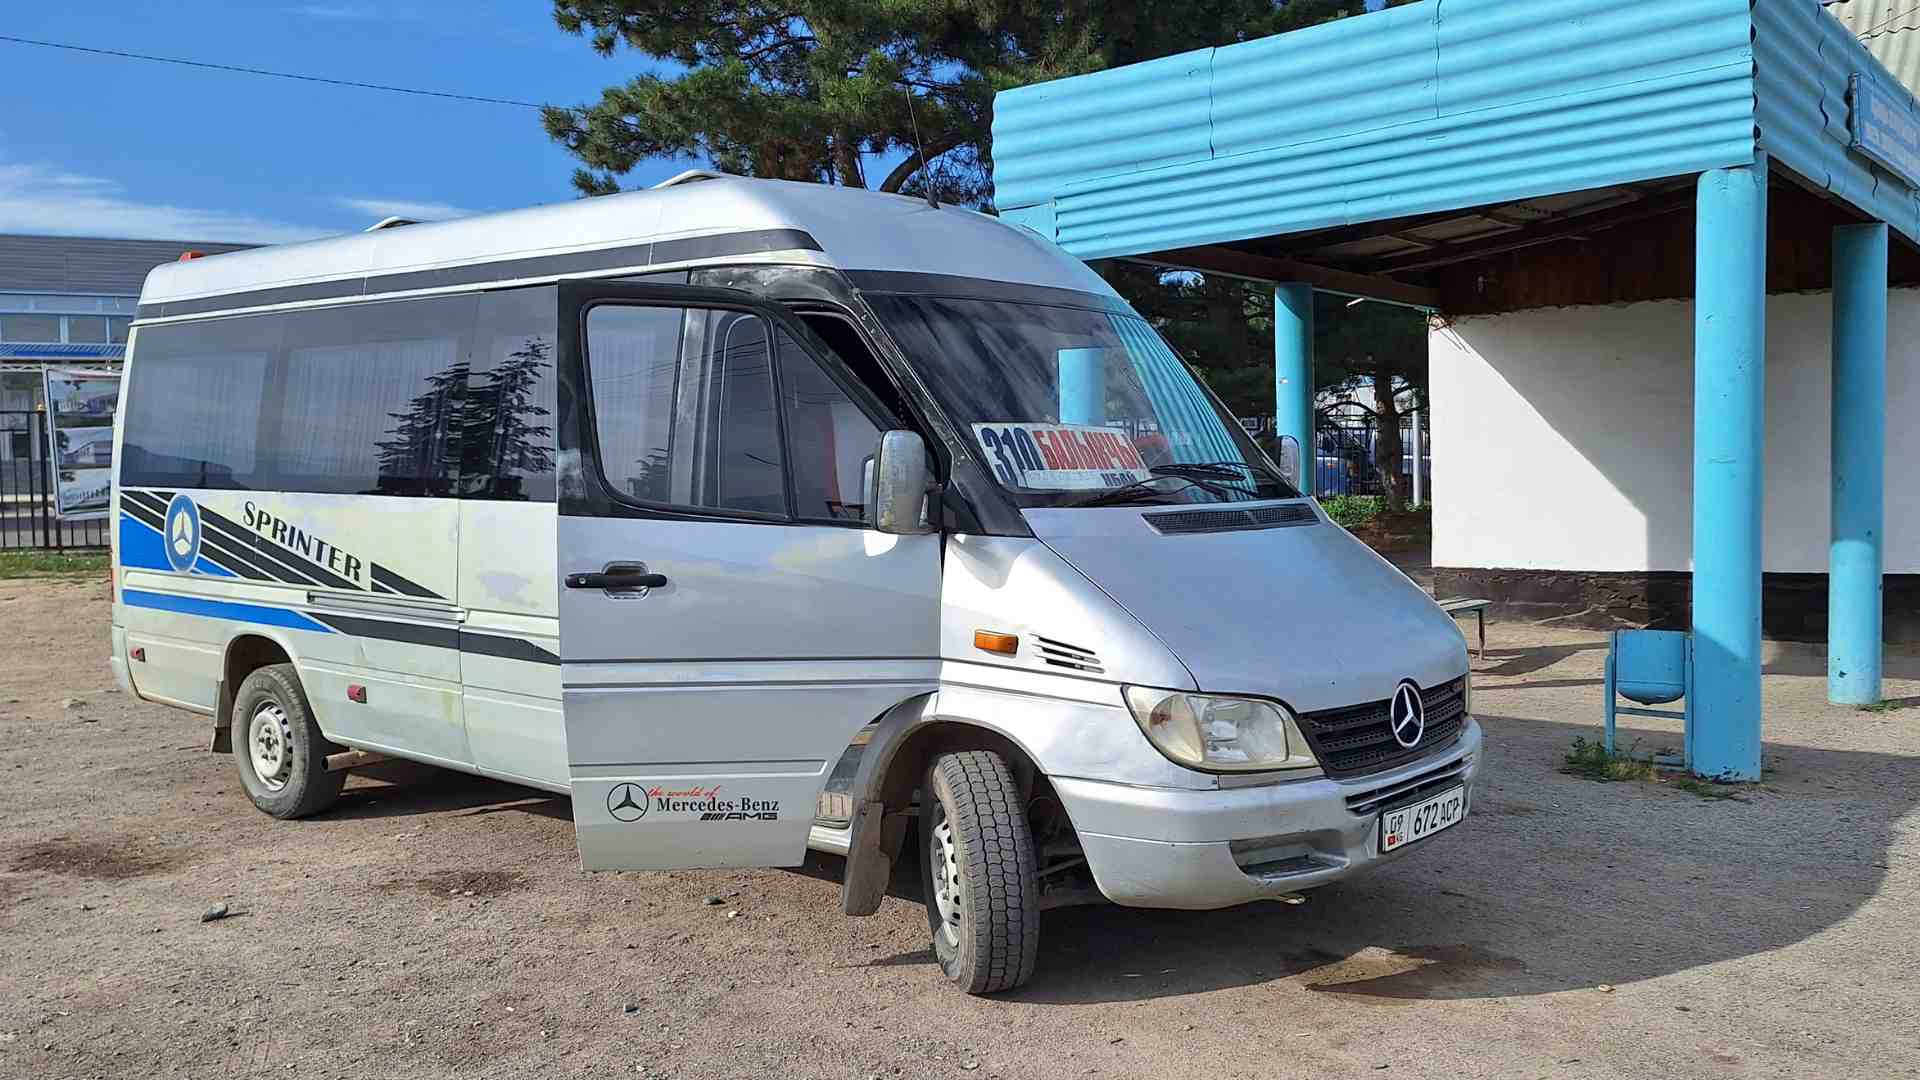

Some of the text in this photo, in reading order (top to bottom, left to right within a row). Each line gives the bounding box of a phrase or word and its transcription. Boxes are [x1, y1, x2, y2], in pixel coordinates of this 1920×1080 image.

[980, 427, 1045, 488] 310
[243, 500, 361, 581] SPRINTER
[648, 784, 721, 801] the world of
[657, 797, 779, 812] Mercedes-Benz
[725, 812, 778, 821] AMG
[1390, 797, 1460, 836] 09 672 ACP
